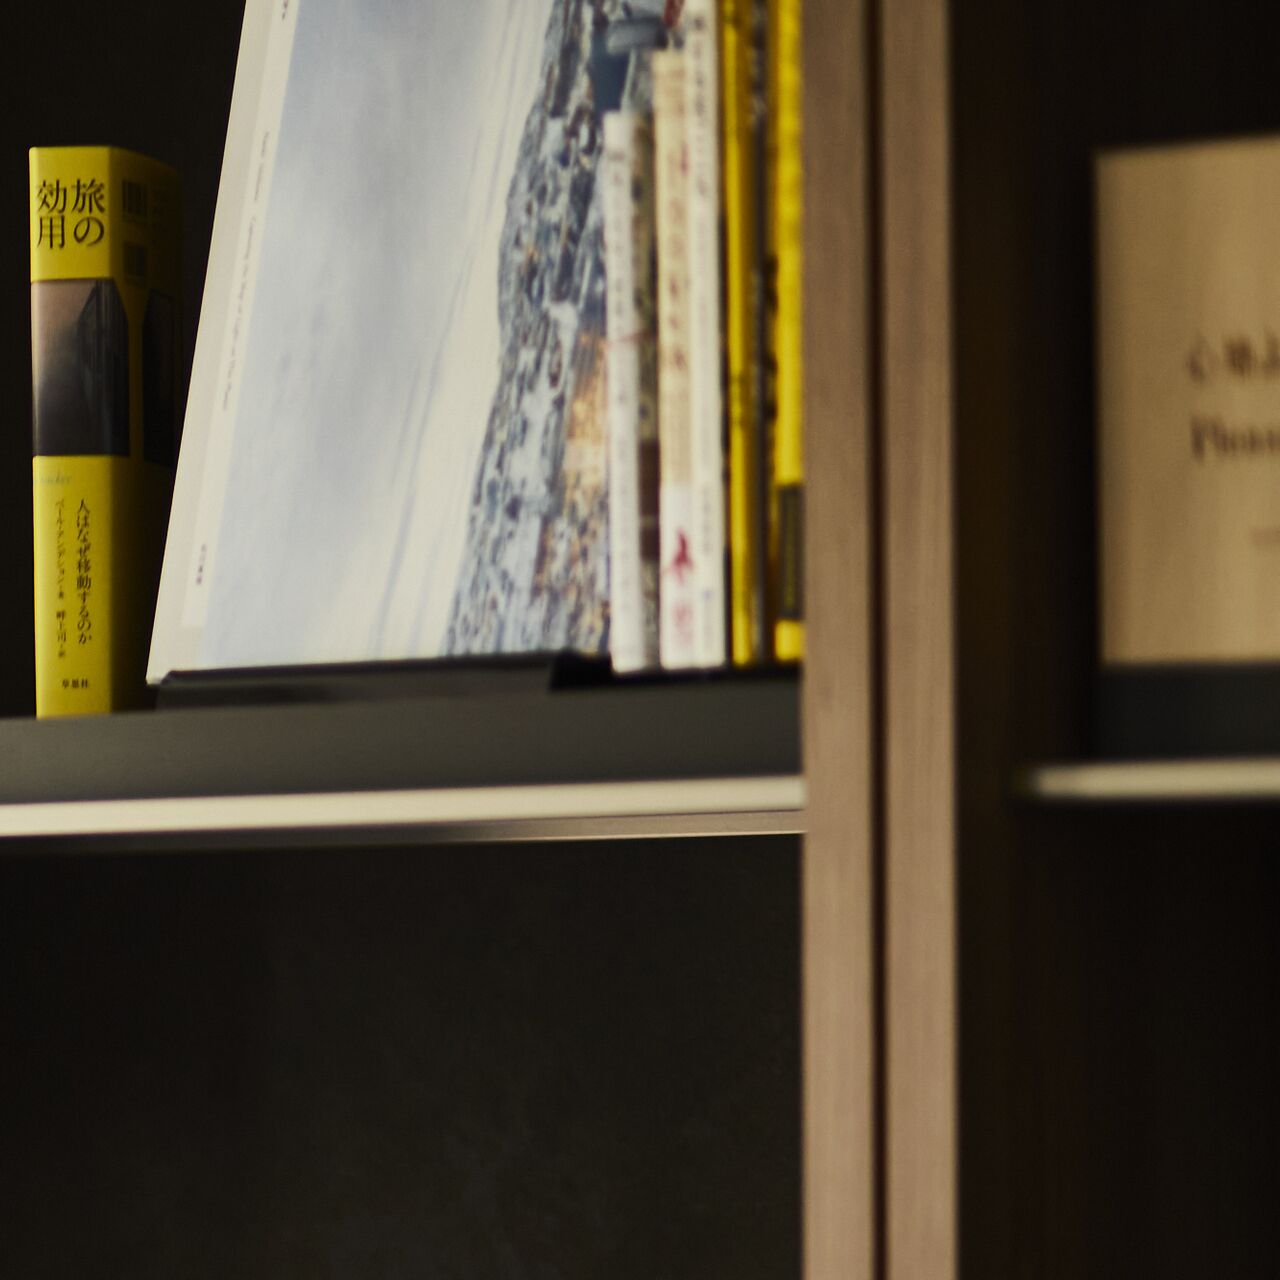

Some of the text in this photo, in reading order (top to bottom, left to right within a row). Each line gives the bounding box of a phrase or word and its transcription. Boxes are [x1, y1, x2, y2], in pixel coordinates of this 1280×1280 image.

[76, 498, 92, 645] 人はなぜ移動するのか
